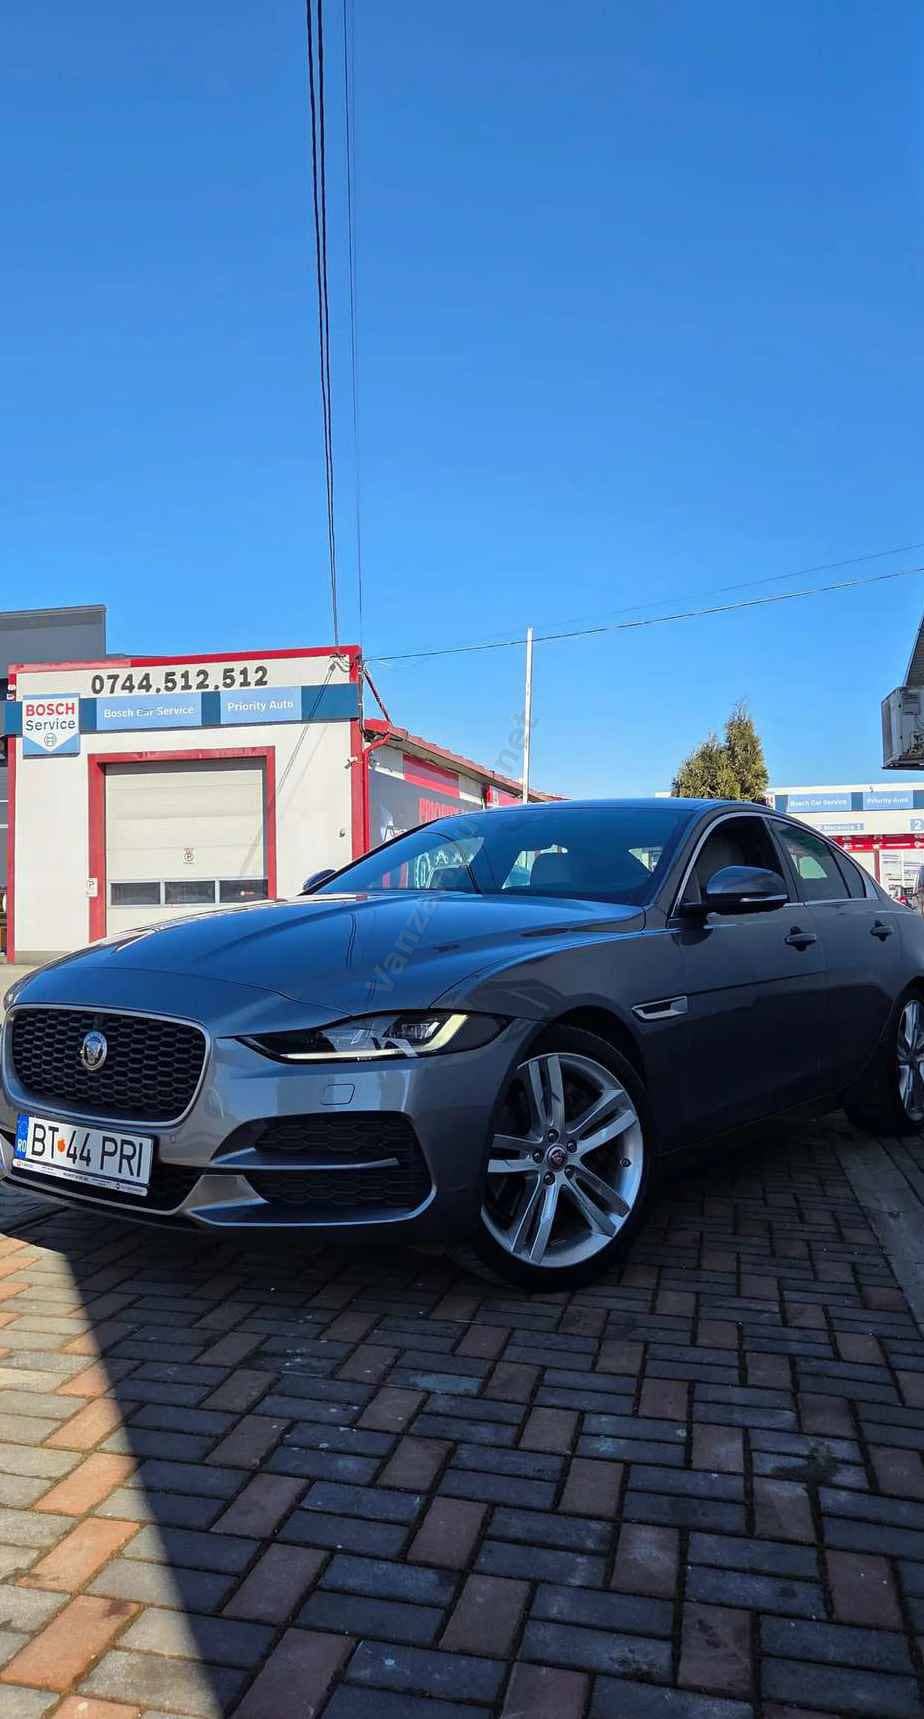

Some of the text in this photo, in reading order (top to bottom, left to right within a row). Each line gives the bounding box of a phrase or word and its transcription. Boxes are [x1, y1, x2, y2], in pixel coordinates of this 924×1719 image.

[91, 665, 268, 695] 0744.512.512
[25, 703, 75, 717] BOSCH
[104, 705, 194, 719] Bosch Car Service
[227, 700, 294, 713] Priority Auto
[25, 717, 76, 731] Service
[913, 820, 922, 830] 2
[16, 1138, 27, 1152] RO
[31, 1123, 144, 1178] BT 44 PRI
